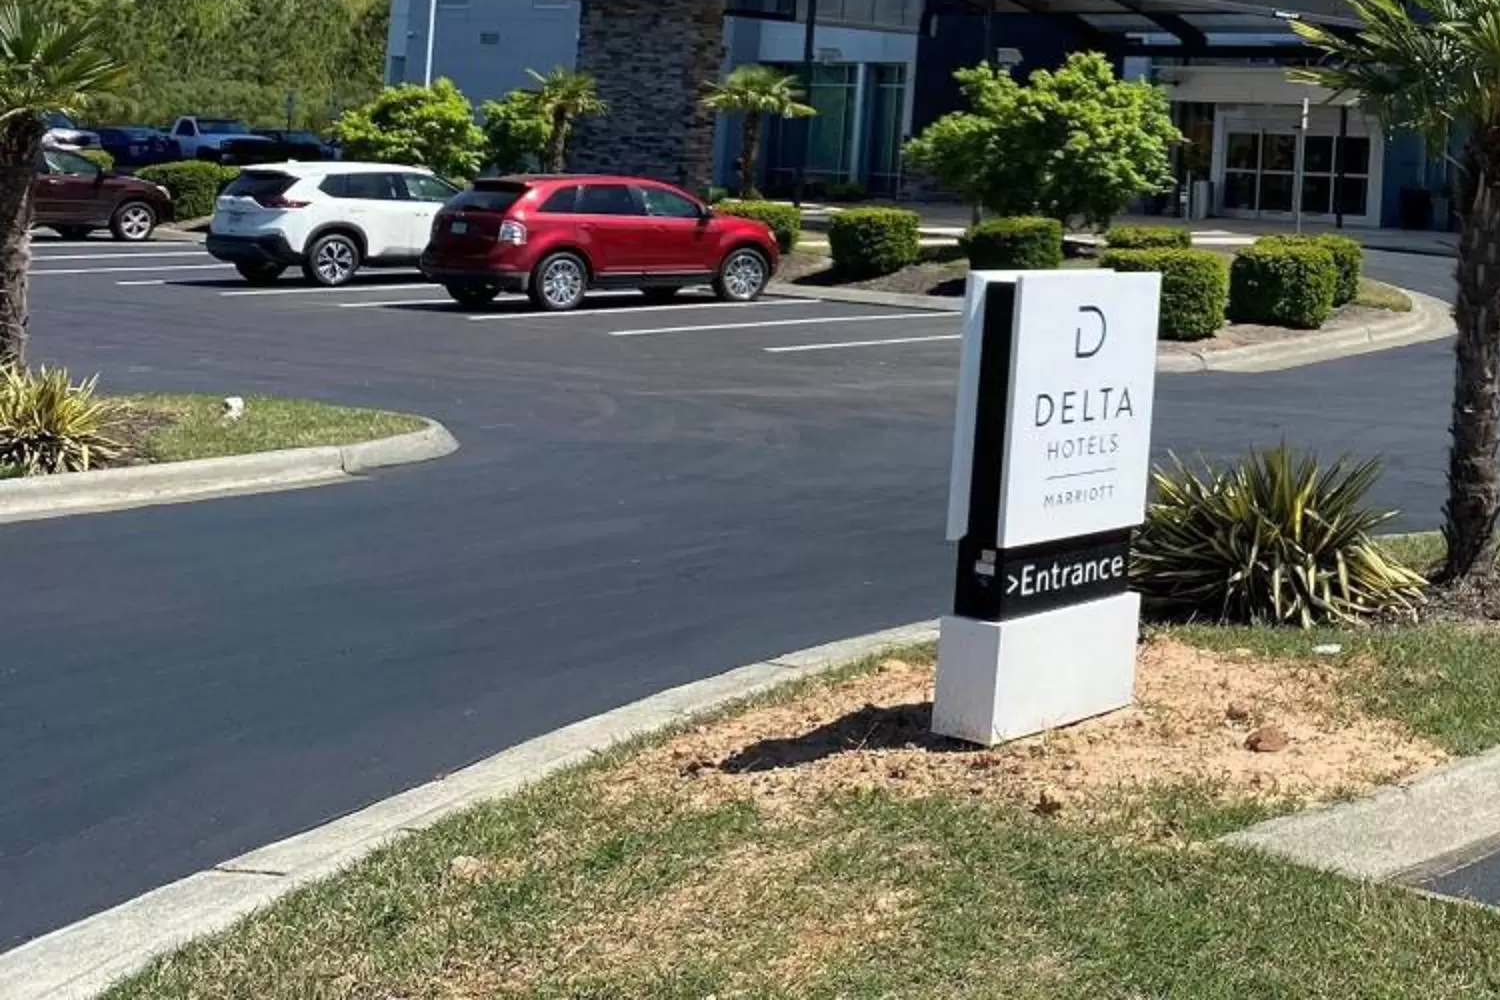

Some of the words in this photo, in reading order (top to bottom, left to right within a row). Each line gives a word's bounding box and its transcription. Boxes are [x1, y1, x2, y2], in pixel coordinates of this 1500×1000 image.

[1035, 386, 1133, 427] DELTA
[1047, 433, 1119, 460] HOTELS
[1043, 485, 1115, 508] MARRIOTT
